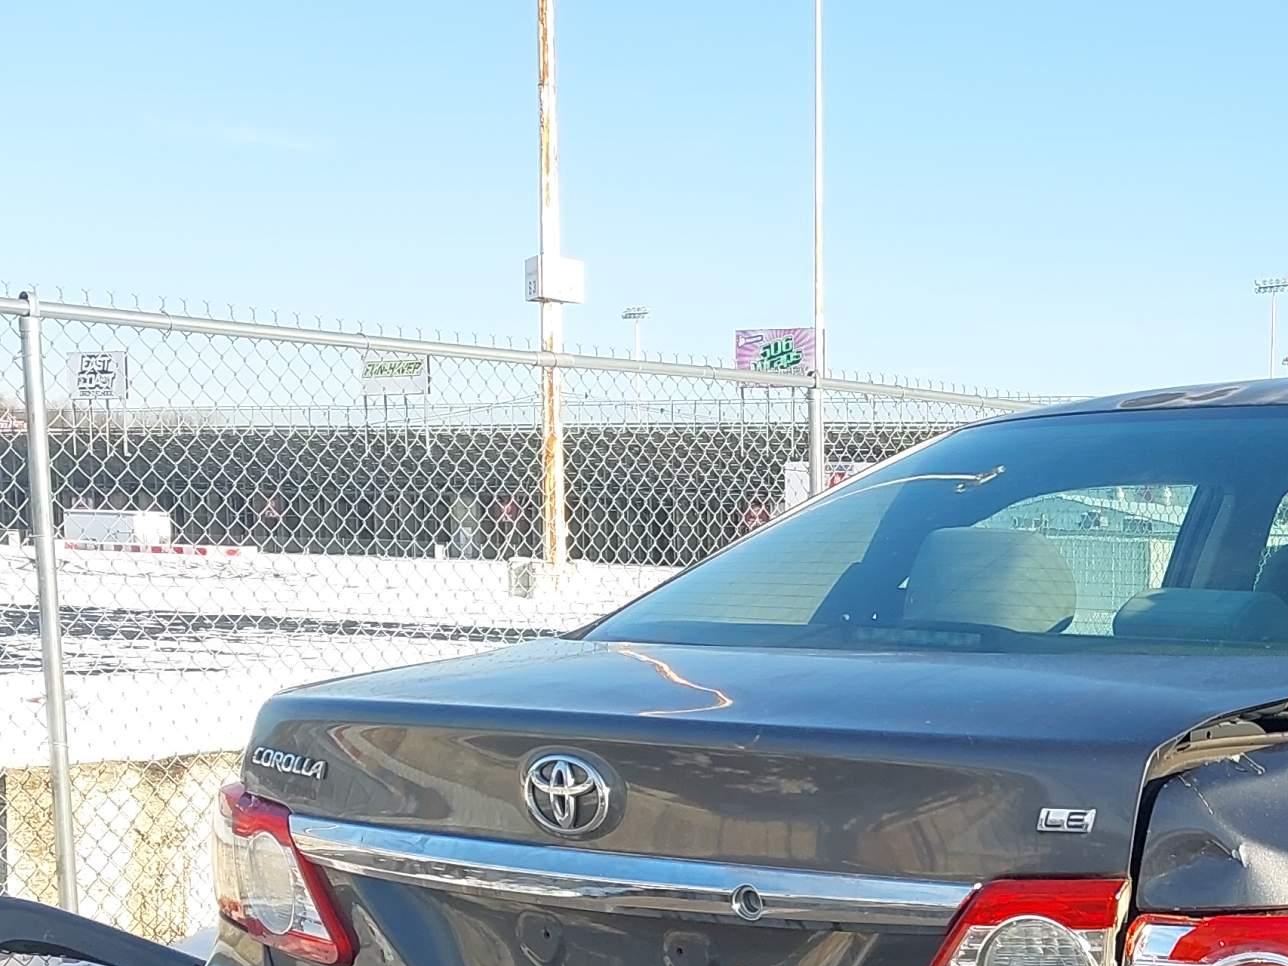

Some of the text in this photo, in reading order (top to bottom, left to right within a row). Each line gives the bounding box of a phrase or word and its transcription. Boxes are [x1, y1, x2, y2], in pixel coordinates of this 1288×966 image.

[759, 336, 794, 358] 506
[80, 354, 112, 373] EAST
[252, 746, 327, 779] COROLLA
[1040, 809, 1092, 831] LE
